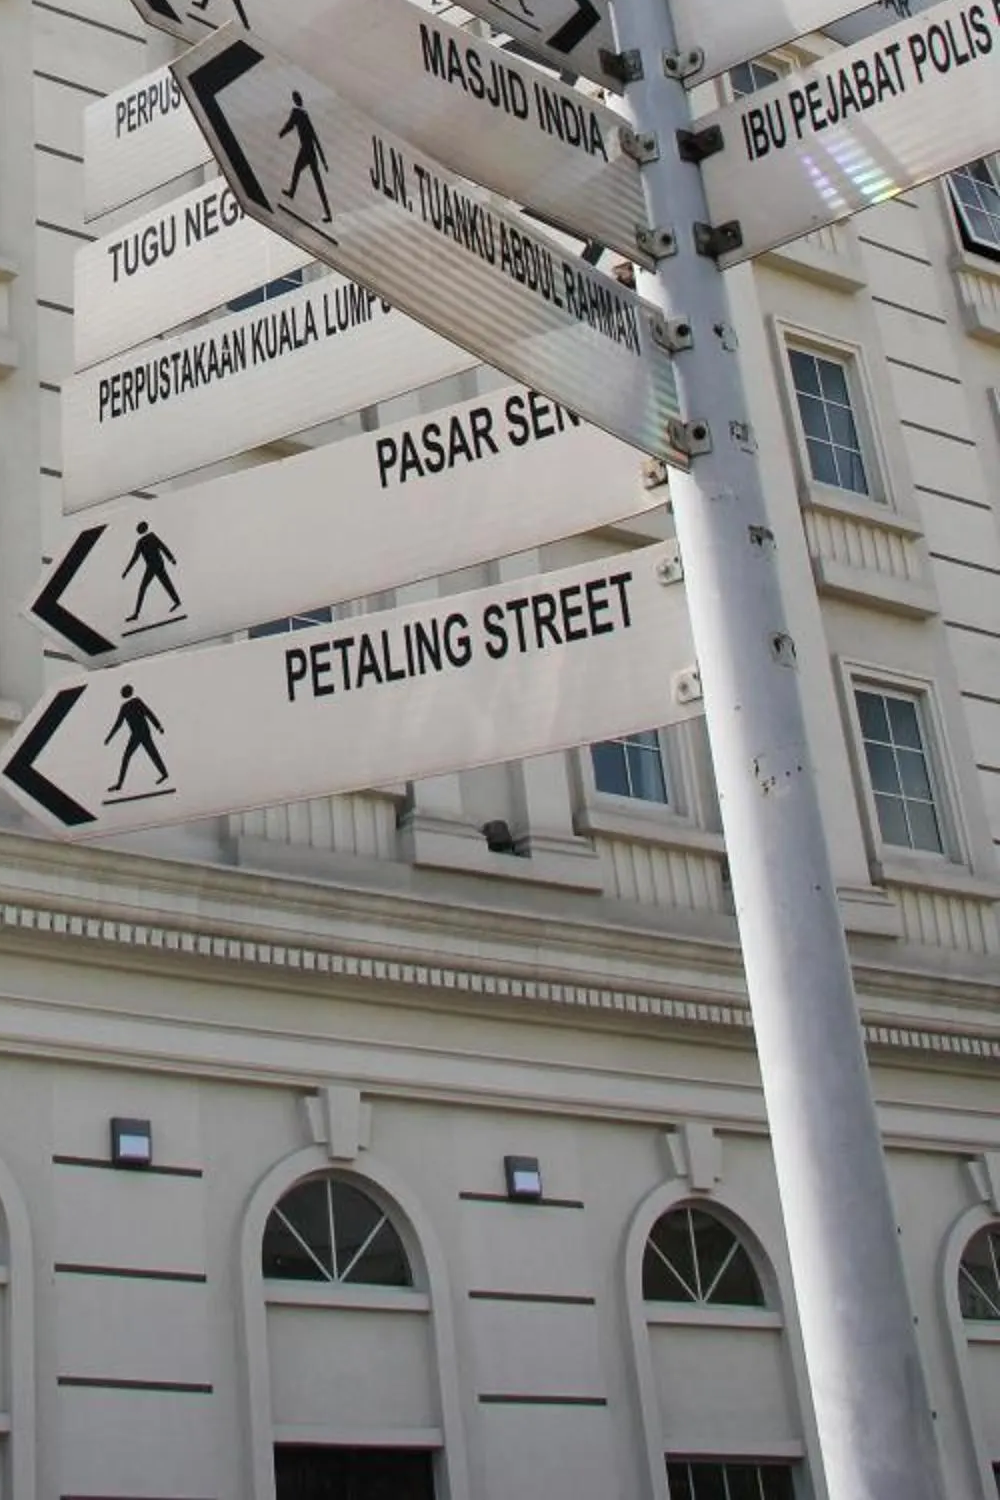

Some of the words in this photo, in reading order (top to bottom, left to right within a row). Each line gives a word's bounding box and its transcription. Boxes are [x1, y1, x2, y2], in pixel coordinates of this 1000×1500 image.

[420, 24, 530, 121] MASJID
[535, 83, 608, 162] INDIA
[741, 98, 787, 161] IBU
[788, 42, 906, 138] PEJABAT
[908, 4, 993, 84] POLIS
[107, 215, 176, 282] TUGU
[185, 187, 244, 247] NEG
[370, 135, 413, 212] JLN.
[413, 163, 496, 266] TUANKU
[500, 221, 563, 307] ABDUL
[562, 262, 641, 356] RAHMAN
[99, 326, 247, 422] PERPUSTAKAAN
[250, 300, 319, 364] KUALA
[376, 407, 500, 488] PASAR
[285, 613, 472, 701] PETALING
[484, 572, 634, 660] STREET
